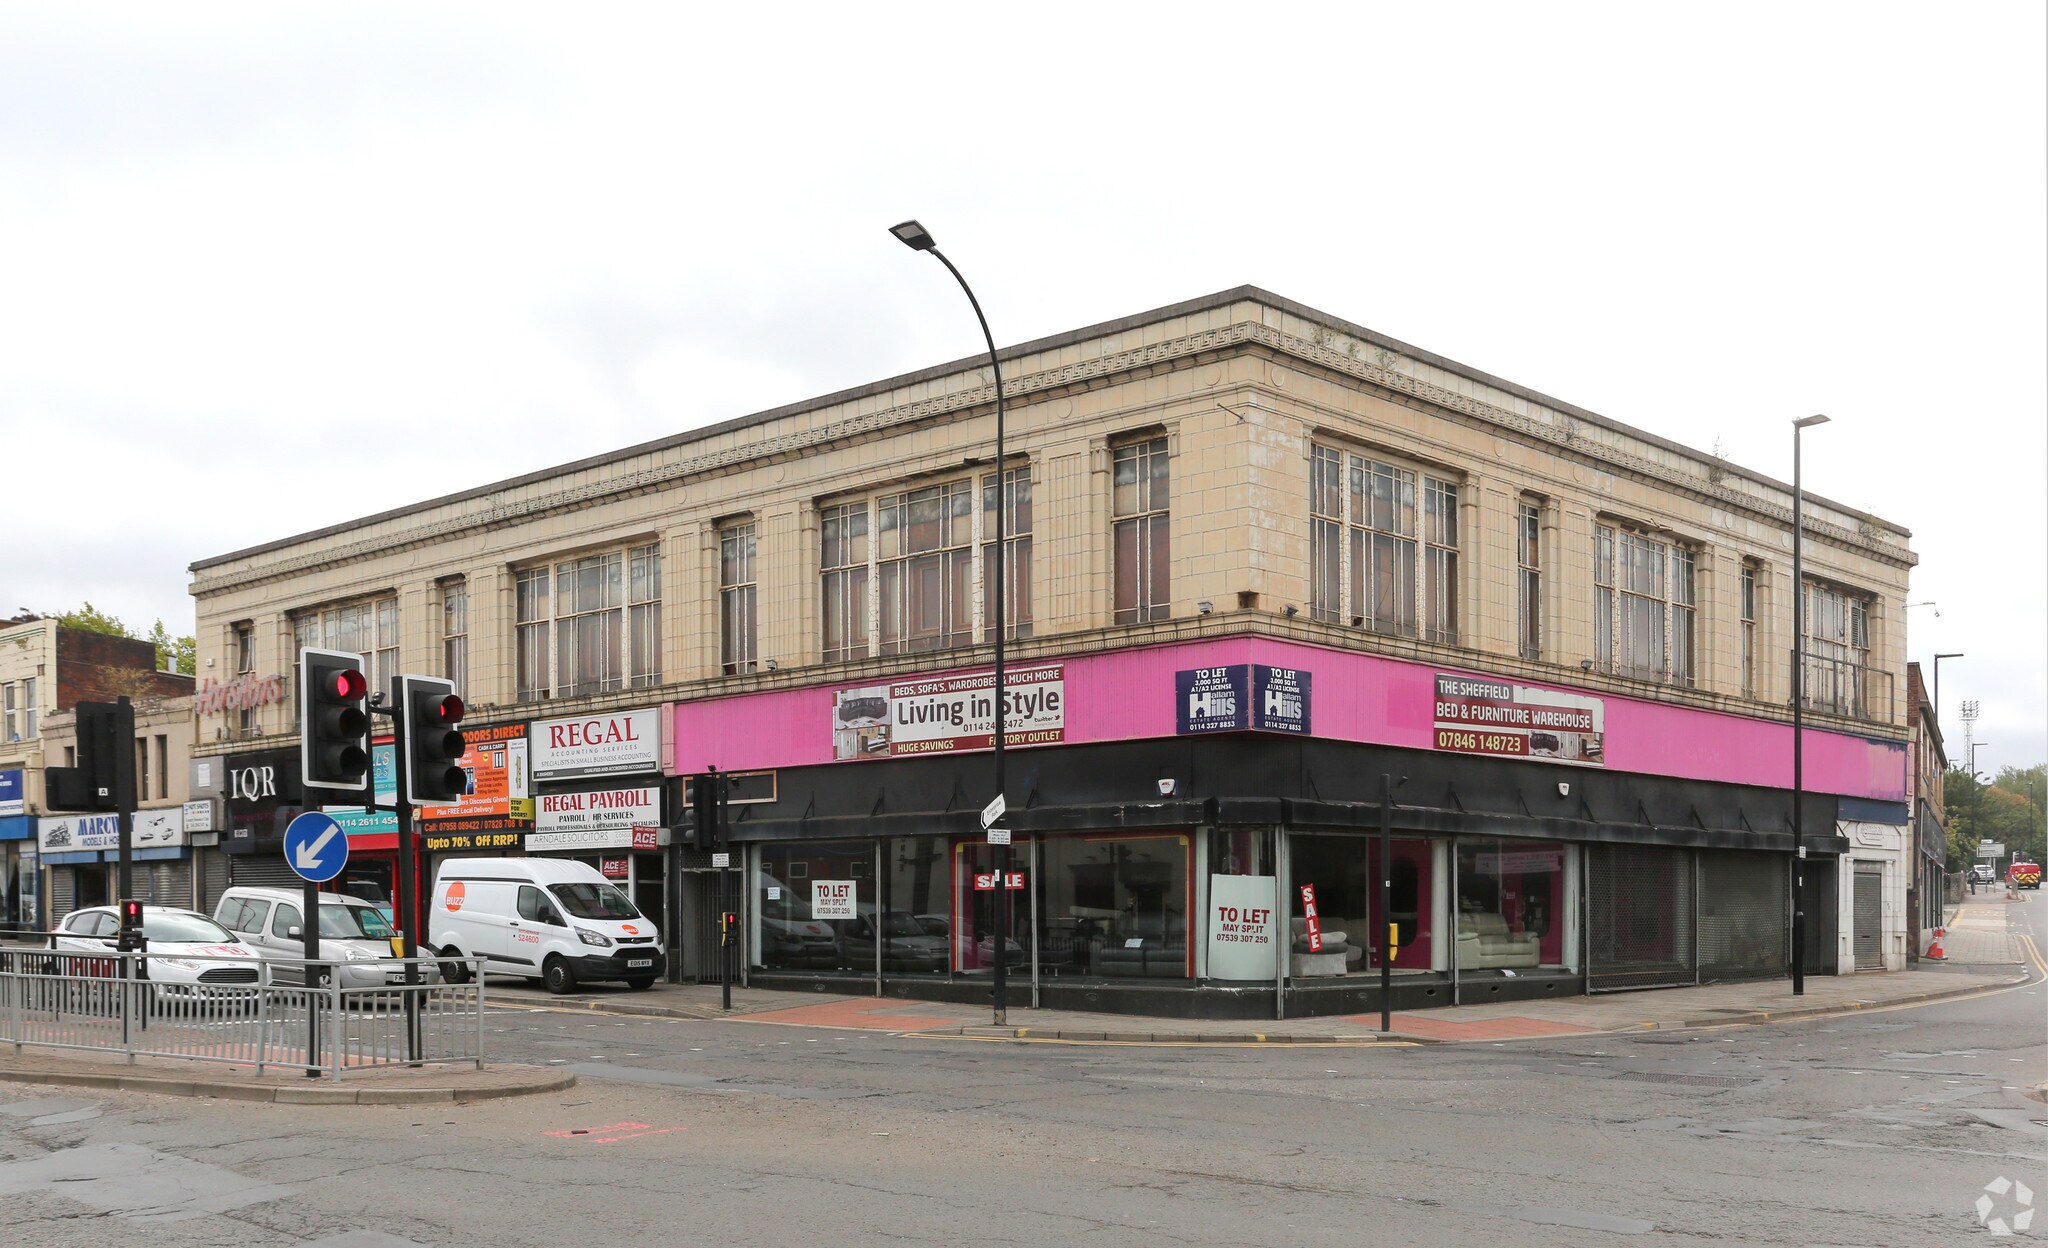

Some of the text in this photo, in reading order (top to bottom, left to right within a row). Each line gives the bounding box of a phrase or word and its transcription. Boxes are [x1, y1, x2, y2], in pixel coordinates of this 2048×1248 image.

[1195, 667, 1227, 680] TO LET
[1270, 667, 1296, 680] TO LET
[894, 669, 1060, 698] BEDS, SOFA'S, WARDROBES MUCH MORE
[1270, 677, 1284, 685] 3,000
[1190, 685, 1210, 693] A1/A2
[1282, 685, 1300, 693] LICENSE
[1438, 679, 1510, 700] THE SHEFFIELD
[898, 687, 1060, 726] Living in Style
[1436, 701, 1591, 729] BED & FURNITURE WAREHOUSE
[963, 721, 984, 733] 0114
[985, 720, 997, 731] 24
[1003, 718, 1024, 729] 2472
[463, 723, 525, 742] DOORS DIRECT
[548, 716, 640, 749] REGAL
[1028, 730, 1061, 742] OUTLET
[478, 744, 490, 752] CASH
[897, 740, 955, 753] HUGE SAVINGS
[1439, 731, 1521, 752] 07846 148723
[551, 743, 638, 757] ACCOUNTING SERVICES
[541, 759, 571, 768] SPECIALISTS
[576, 757, 593, 765] SMALL
[593, 755, 617, 764] BUSINESS
[617, 751, 652, 761] ACCOUNTING
[229, 765, 277, 802] IQR
[470, 798, 493, 806] Discounts
[493, 795, 509, 804] Given!
[543, 789, 652, 812] REGAL PAYROLL
[436, 805, 495, 816] Plus FREE Local Delivery!
[558, 814, 586, 823] PAYROLL
[592, 812, 602, 821] HR
[603, 810, 634, 820] SERVICES
[358, 817, 380, 827] 2611
[424, 823, 438, 831] Call:
[439, 822, 457, 831] 07958
[458, 821, 480, 830] 089422
[484, 819, 503, 829] 07828
[504, 819, 516, 828] 708
[629, 819, 659, 827] SPECIALISTS
[82, 836, 107, 847] MODELS &
[427, 833, 519, 850] Upto 70% Off RRP!
[533, 831, 609, 844] ARNDALE SOLICITORS
[633, 832, 656, 844] ACE
[603, 861, 619, 870] ACE
[977, 874, 1022, 888] SLE
[816, 884, 850, 898] TO LET
[446, 896, 464, 906] BUZZ
[820, 898, 847, 906] MAY SPLIT
[816, 906, 851, 915] 07539 307 250
[1218, 906, 1270, 924] TO LET
[1303, 887, 1320, 950] SALE
[1222, 923, 1240, 932] MAY
[517, 934, 540, 944] 524600
[1216, 933, 1269, 944] 07539 307 250
